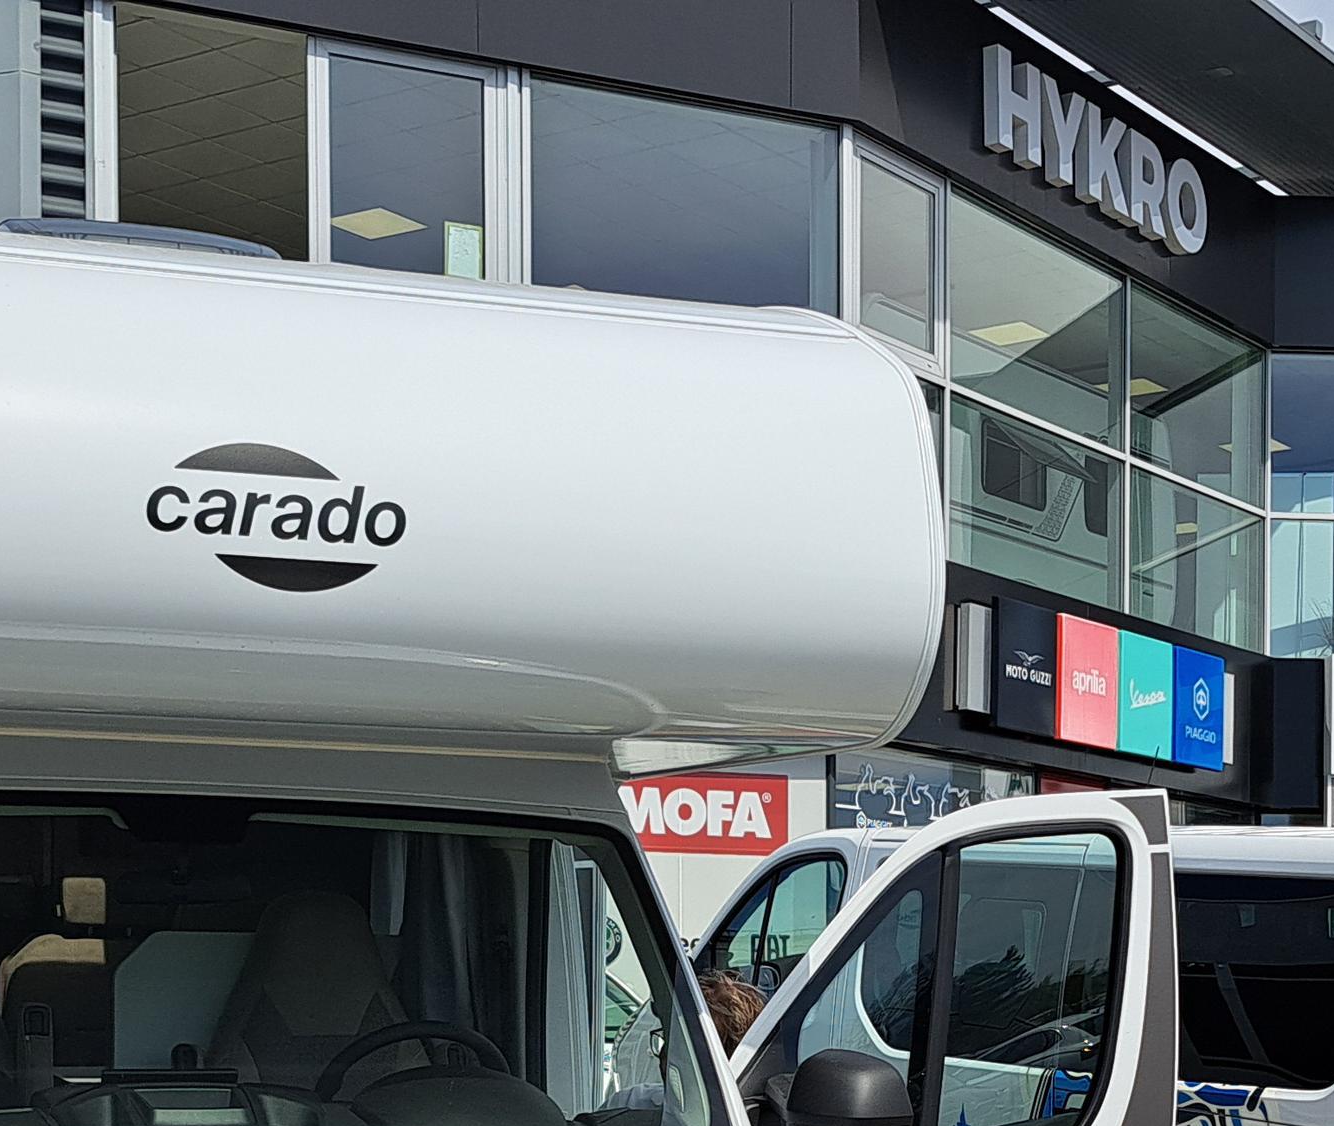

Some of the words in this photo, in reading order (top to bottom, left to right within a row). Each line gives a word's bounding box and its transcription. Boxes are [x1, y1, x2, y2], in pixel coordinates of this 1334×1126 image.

[982, 44, 1207, 255] HYKRO
[146, 485, 407, 547] carado
[1005, 664, 1029, 681] MOTO
[1029, 669, 1052, 687] GUZZI
[1072, 668, 1107, 696] aprilia
[1130, 678, 1167, 709] Vespa
[1185, 725, 1216, 744] PIAGGIO
